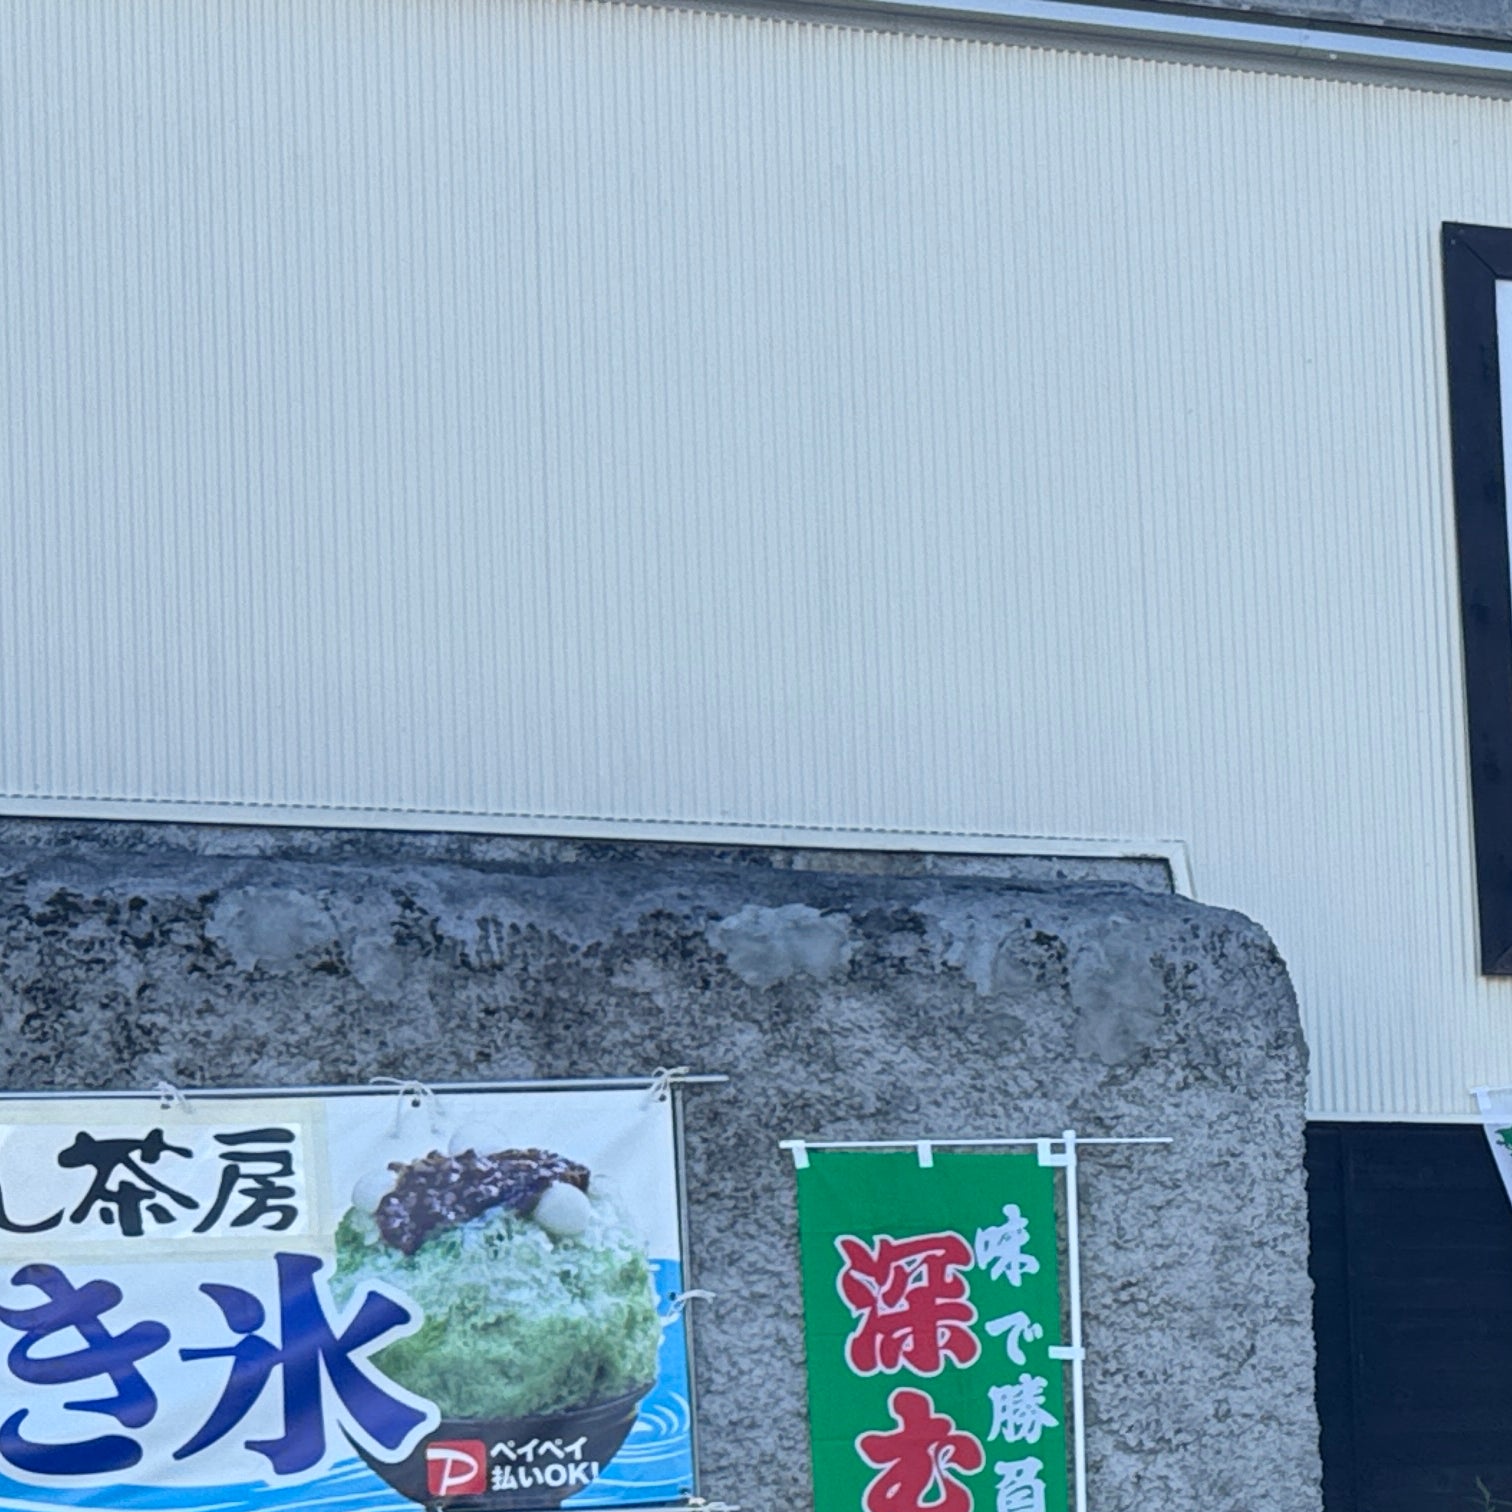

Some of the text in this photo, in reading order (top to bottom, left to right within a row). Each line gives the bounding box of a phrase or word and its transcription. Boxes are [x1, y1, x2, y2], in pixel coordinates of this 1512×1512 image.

[0, 1251, 428, 1477] き氷
[490, 1436, 588, 1463] ペイペイ
[491, 1460, 600, 1492] 払いOK!
